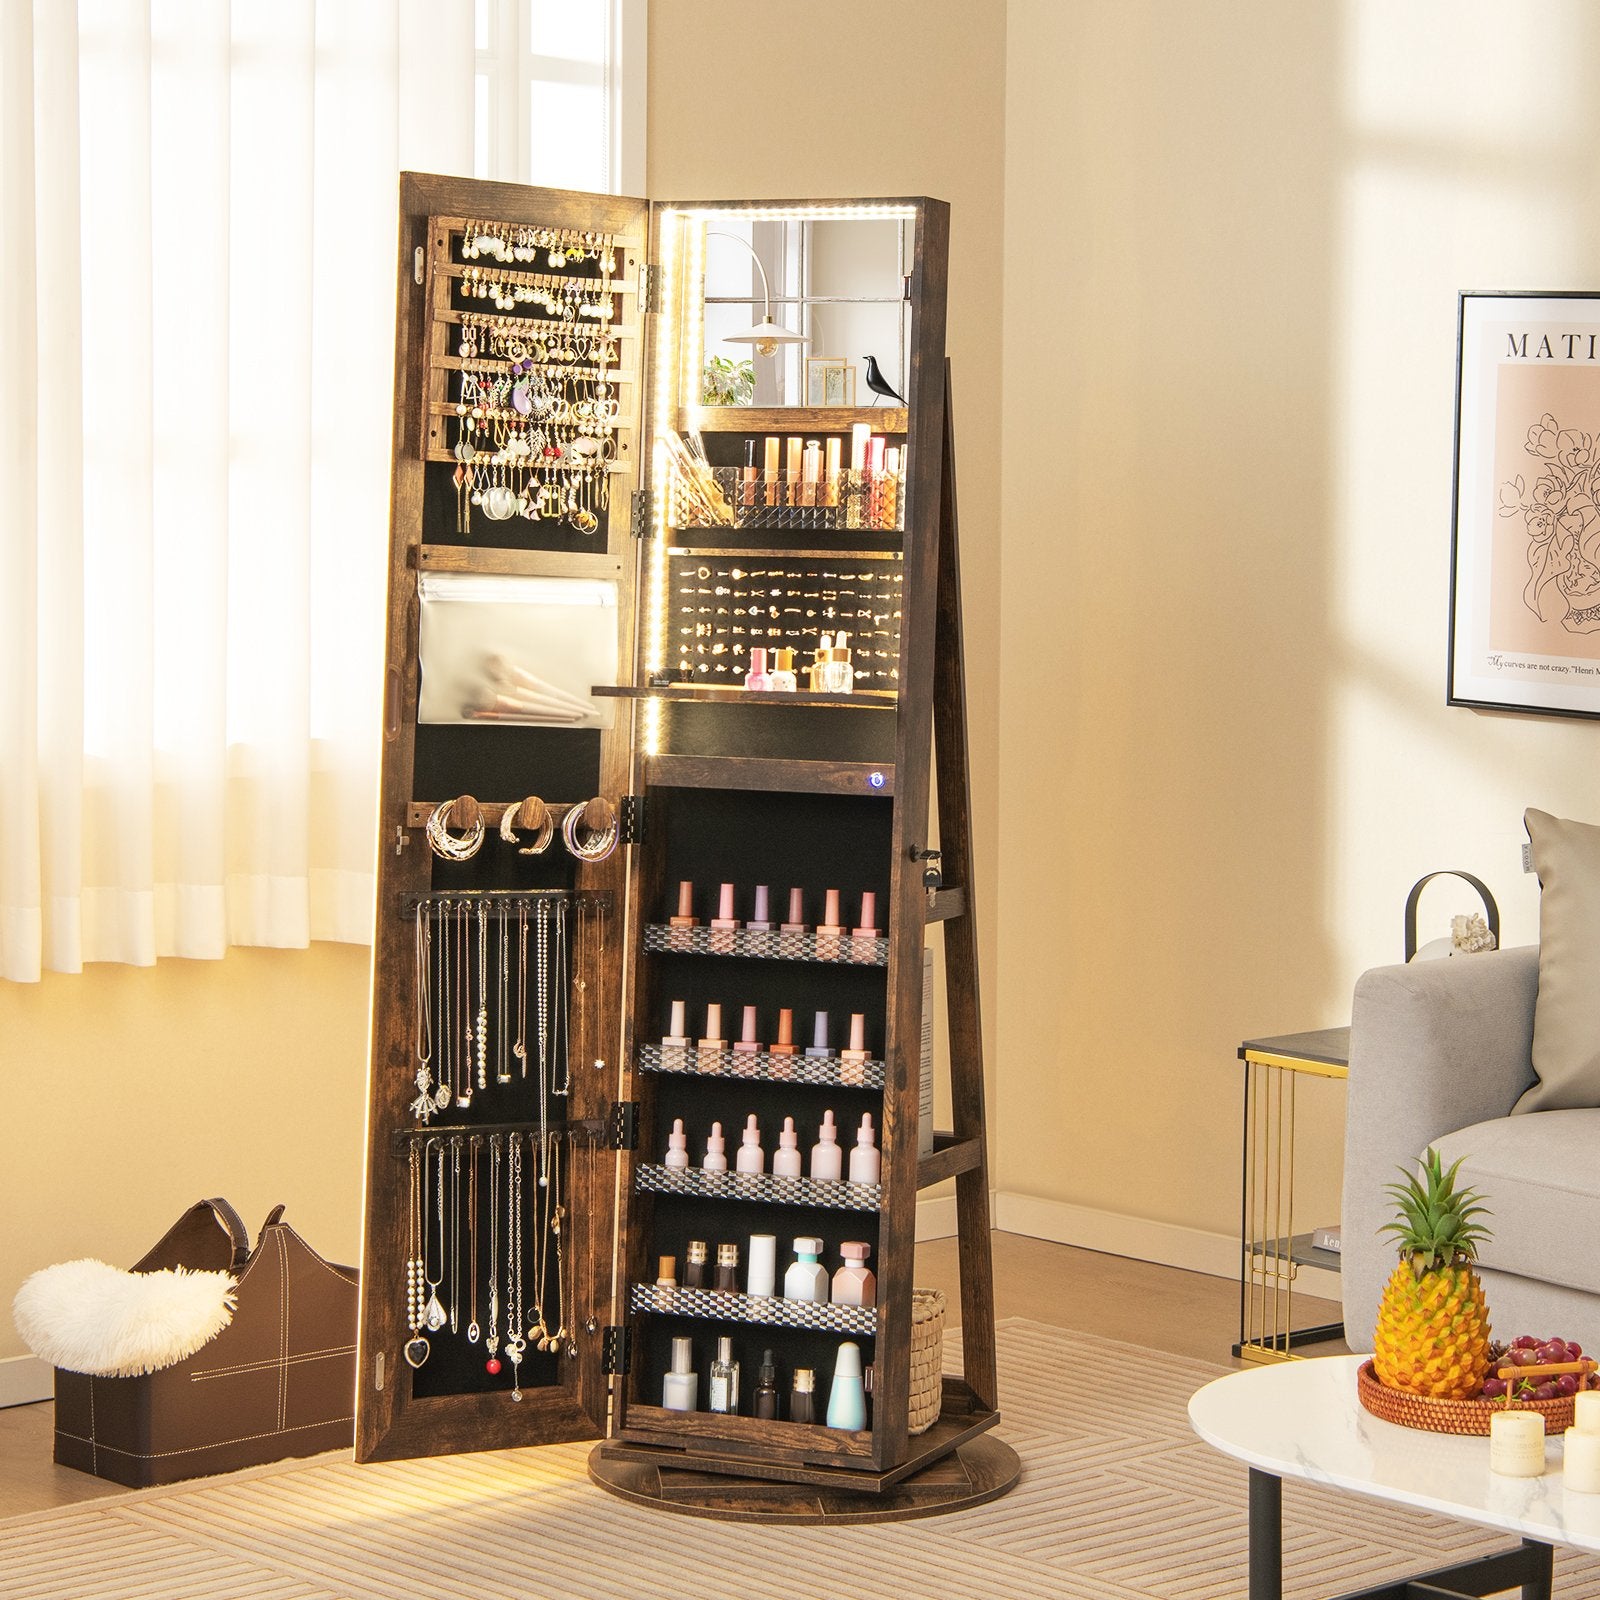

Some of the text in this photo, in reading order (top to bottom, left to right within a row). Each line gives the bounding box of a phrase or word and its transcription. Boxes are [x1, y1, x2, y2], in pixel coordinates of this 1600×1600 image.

[1506, 333, 1597, 360] MATI
[1504, 660, 1526, 669] curves
[1527, 662, 1538, 670] are
[1539, 663, 1550, 671] not
